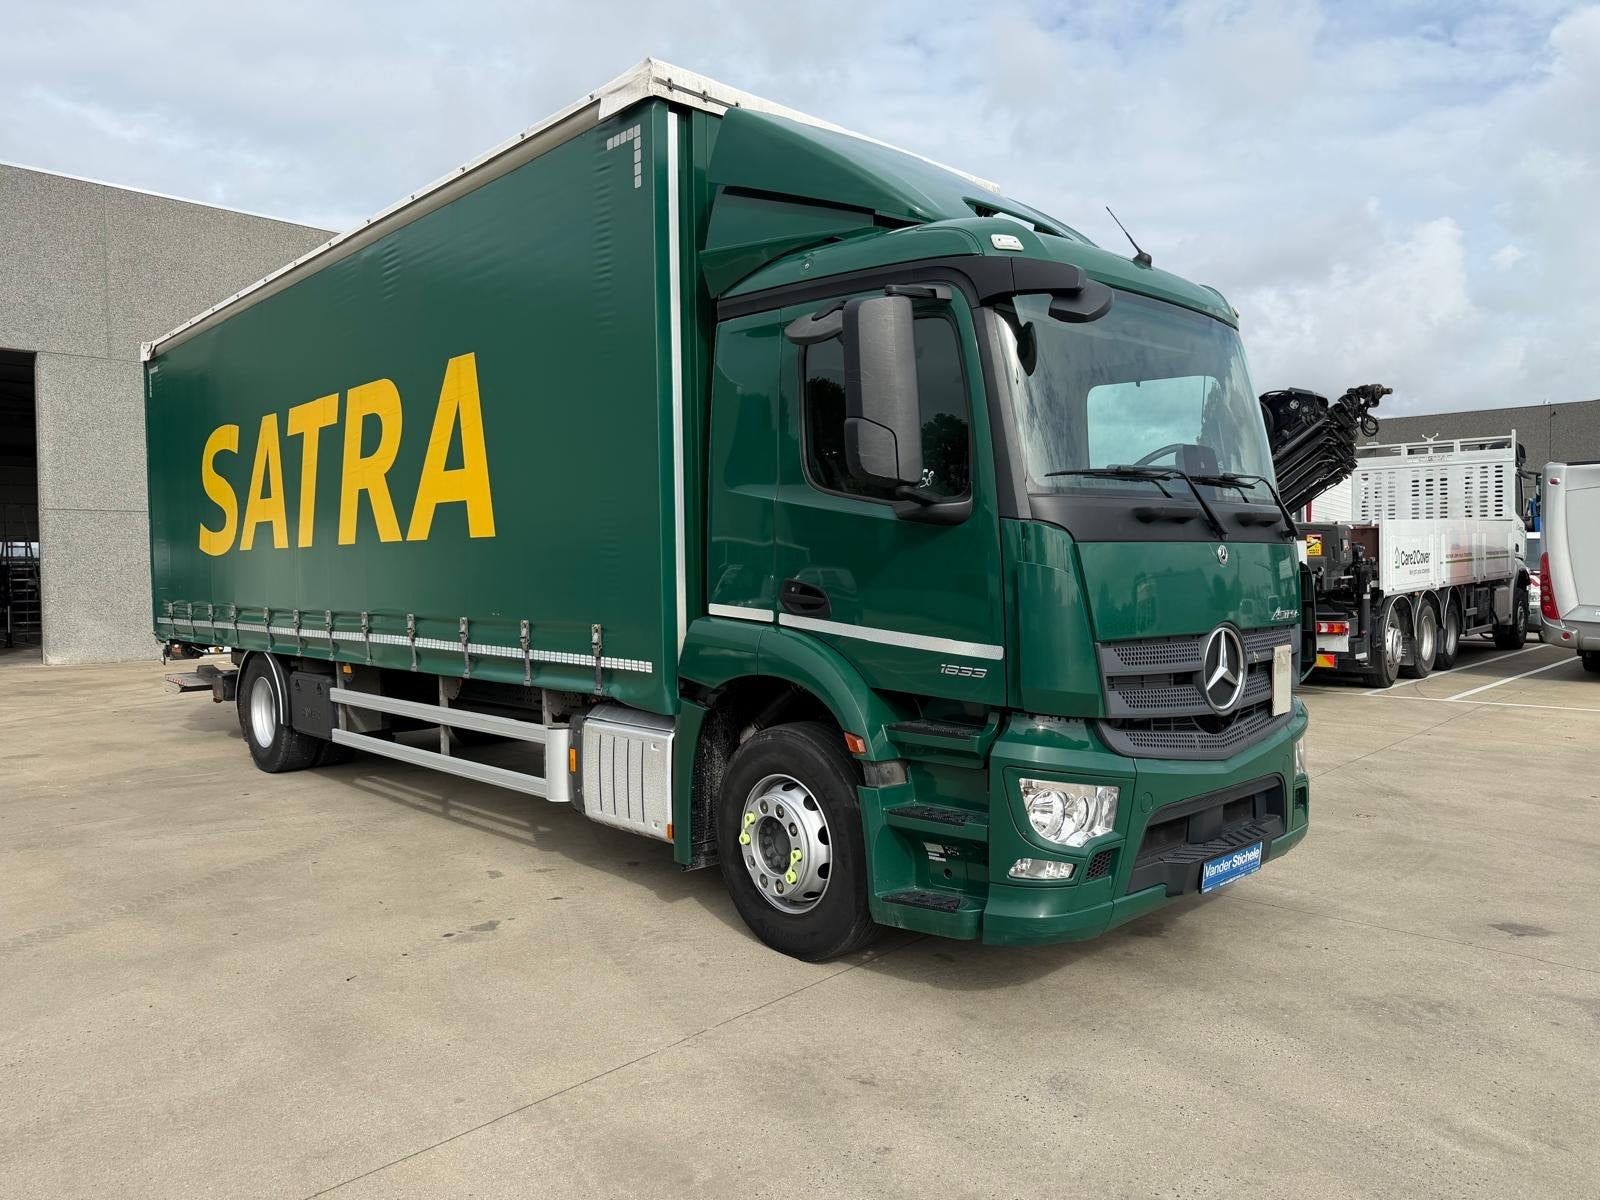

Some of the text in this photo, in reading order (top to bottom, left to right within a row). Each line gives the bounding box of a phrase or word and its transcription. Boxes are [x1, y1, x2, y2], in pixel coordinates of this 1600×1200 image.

[199, 352, 496, 557] SATRA
[1205, 860, 1233, 878] Vander
[1232, 847, 1260, 868] Stichele
